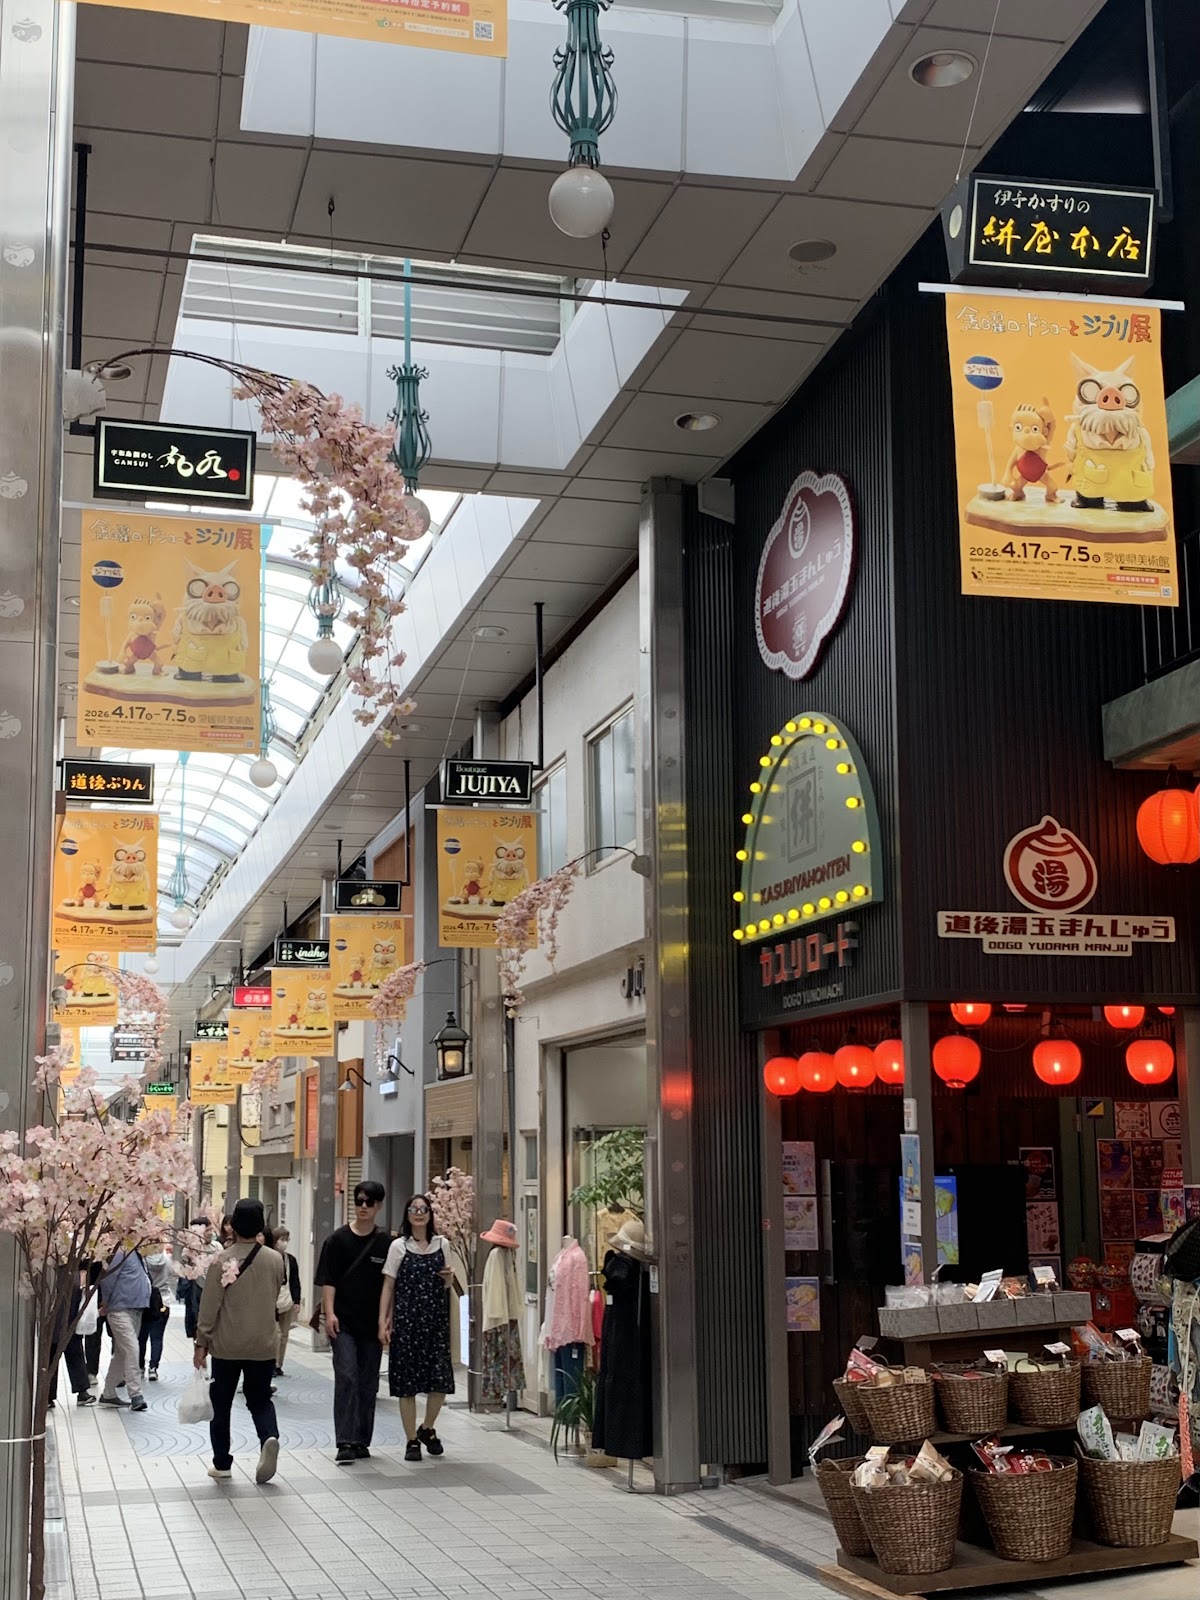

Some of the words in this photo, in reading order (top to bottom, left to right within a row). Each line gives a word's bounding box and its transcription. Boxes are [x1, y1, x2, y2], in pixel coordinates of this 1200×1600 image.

[994, 188, 1090, 214] 伊予かすりの
[981, 215, 1141, 261] 絣屋本店
[113, 458, 149, 468] GANSUI
[1103, 551, 1170, 567] 愛媛県美術館
[455, 764, 488, 774] Boutique
[70, 773, 146, 791] 道後ぷりん
[455, 774, 521, 795] JUJIYA
[760, 853, 851, 906] KASURIYAHONTEN
[1031, 859, 1070, 898] 湯
[944, 914, 1170, 940] 道後湯玉まんじゅう
[298, 945, 327, 958] inaho
[988, 941, 1023, 951] DOGO
[1027, 941, 1080, 952] YUDAMA
[1084, 943, 1129, 953] MANJU
